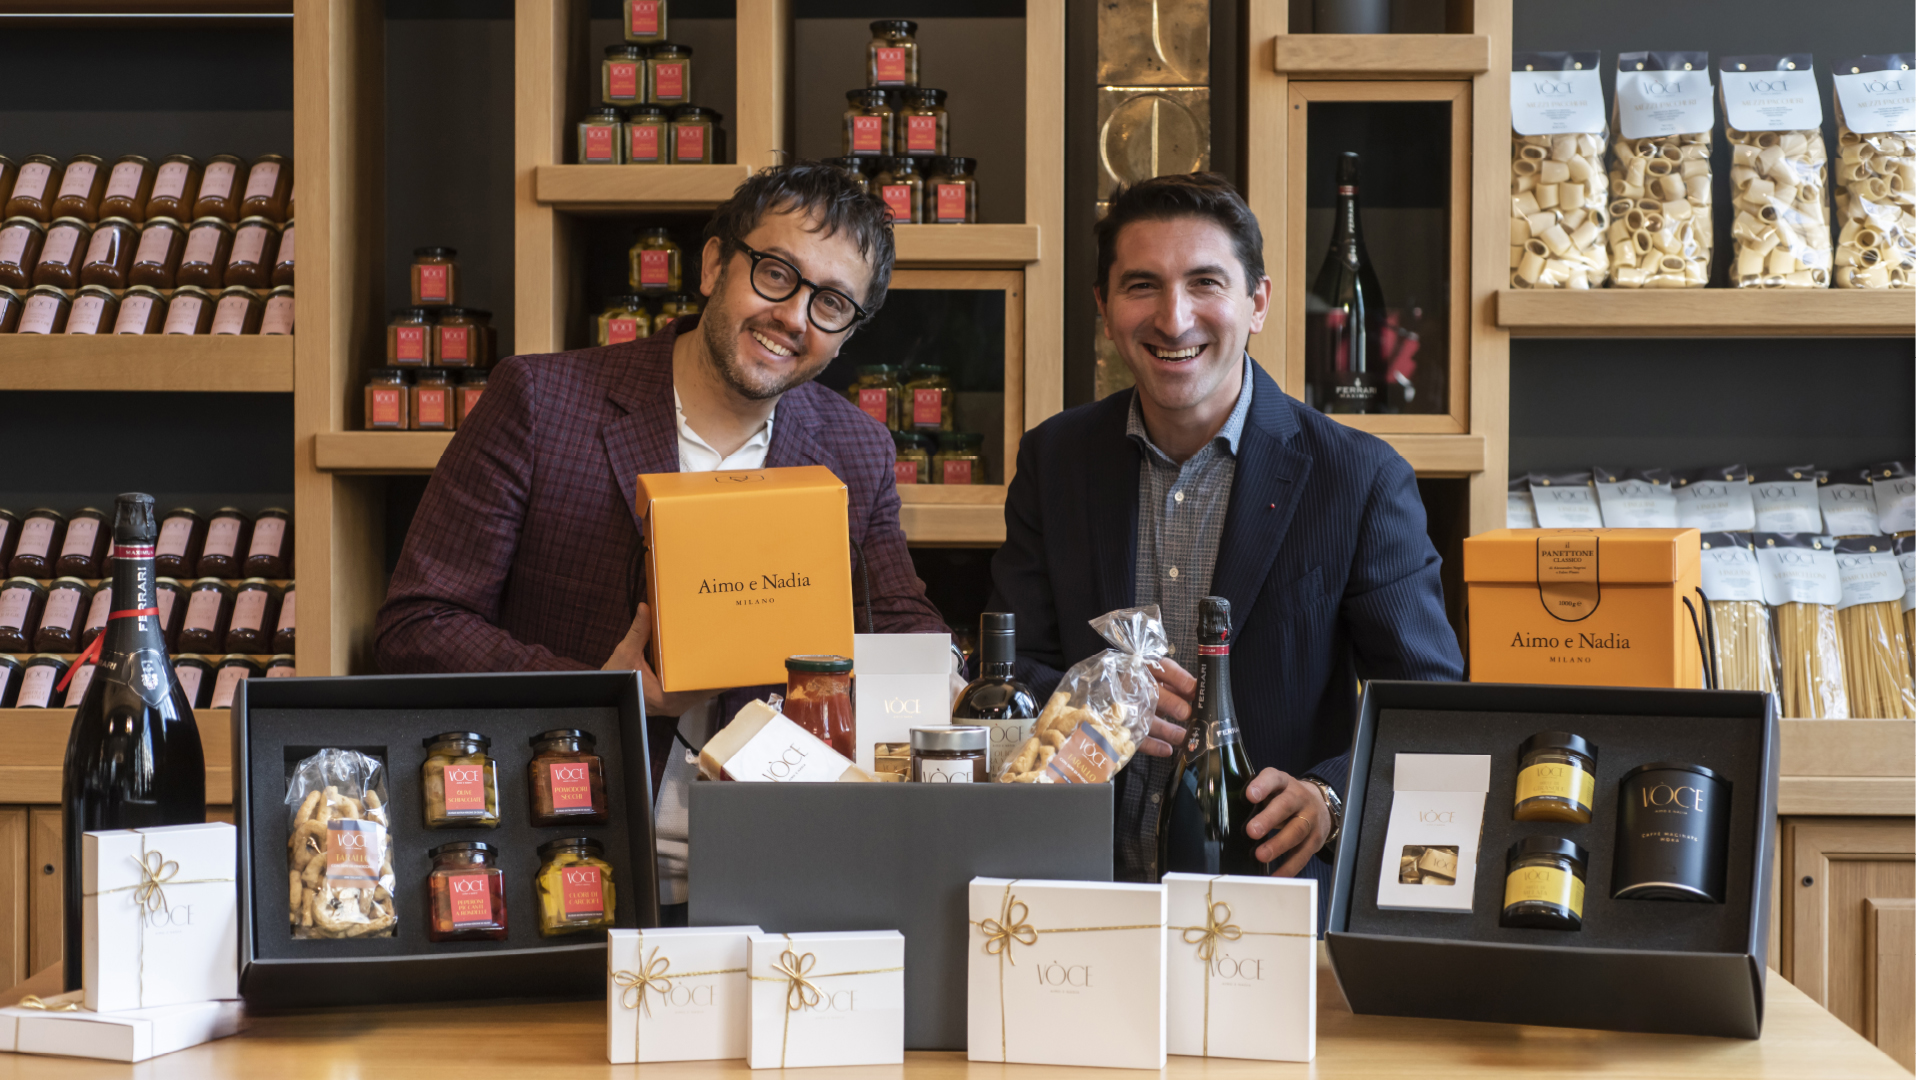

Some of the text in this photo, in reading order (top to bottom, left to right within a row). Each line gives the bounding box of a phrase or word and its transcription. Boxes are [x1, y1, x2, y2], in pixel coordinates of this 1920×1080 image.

[698, 572, 811, 594] Aimo e Nadia
[137, 567, 148, 632] FERRARI
[735, 598, 775, 606] MILANO
[1510, 632, 1631, 649] Aimo e Nadia
[1197, 663, 1207, 709] FERRARI
[884, 697, 921, 714] VÒCE
[990, 723, 1024, 744] ÒCE
[1080, 738, 1108, 769] VÒCE
[449, 768, 479, 781] VÒCE
[555, 766, 585, 780] VÒCE
[1068, 753, 1096, 782] TARALLO
[1642, 781, 1704, 812] VÒCE
[454, 878, 484, 893] VÒCE
[567, 870, 597, 884] VÒCE
[1037, 960, 1093, 987] VÒCE
[1210, 953, 1264, 981] VÒCE
